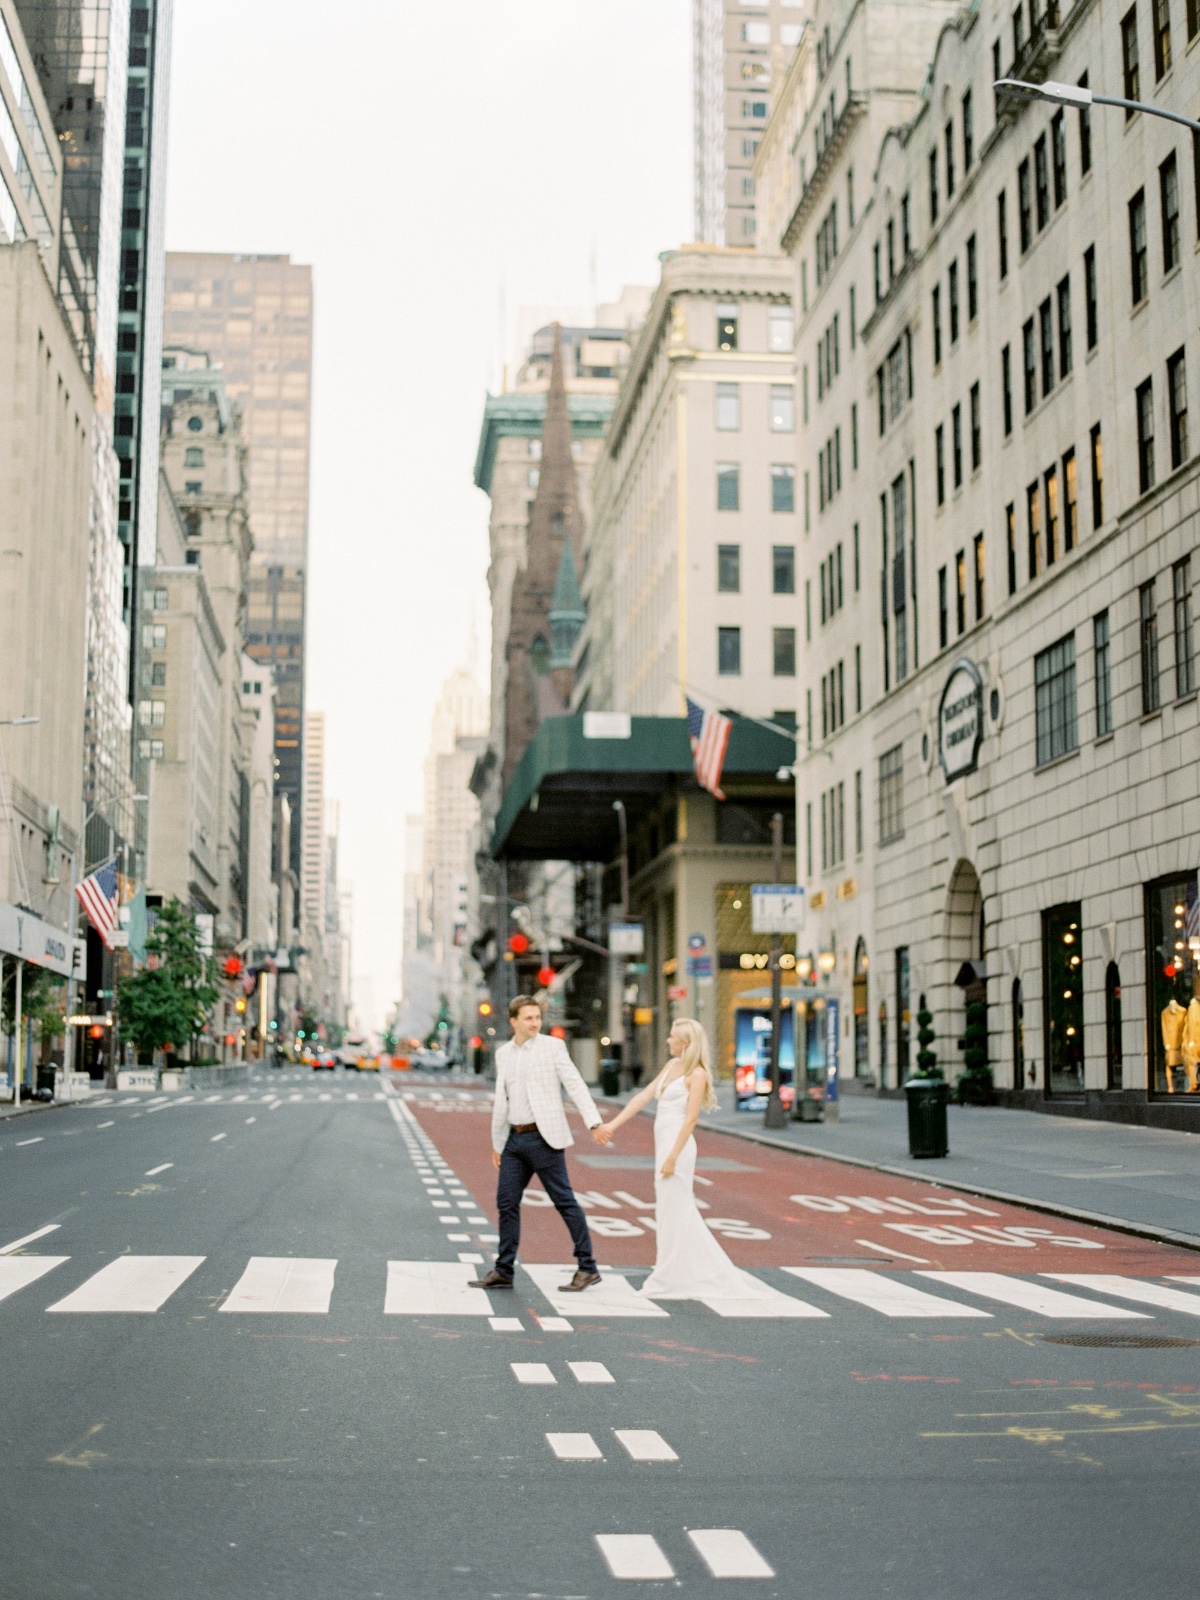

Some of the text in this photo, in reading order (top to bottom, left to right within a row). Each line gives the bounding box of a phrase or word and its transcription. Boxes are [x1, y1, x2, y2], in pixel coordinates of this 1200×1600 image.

[520, 1189, 712, 1210] ONL
[789, 1194, 1002, 1217] ONLY
[881, 1223, 1106, 1249] BUS
